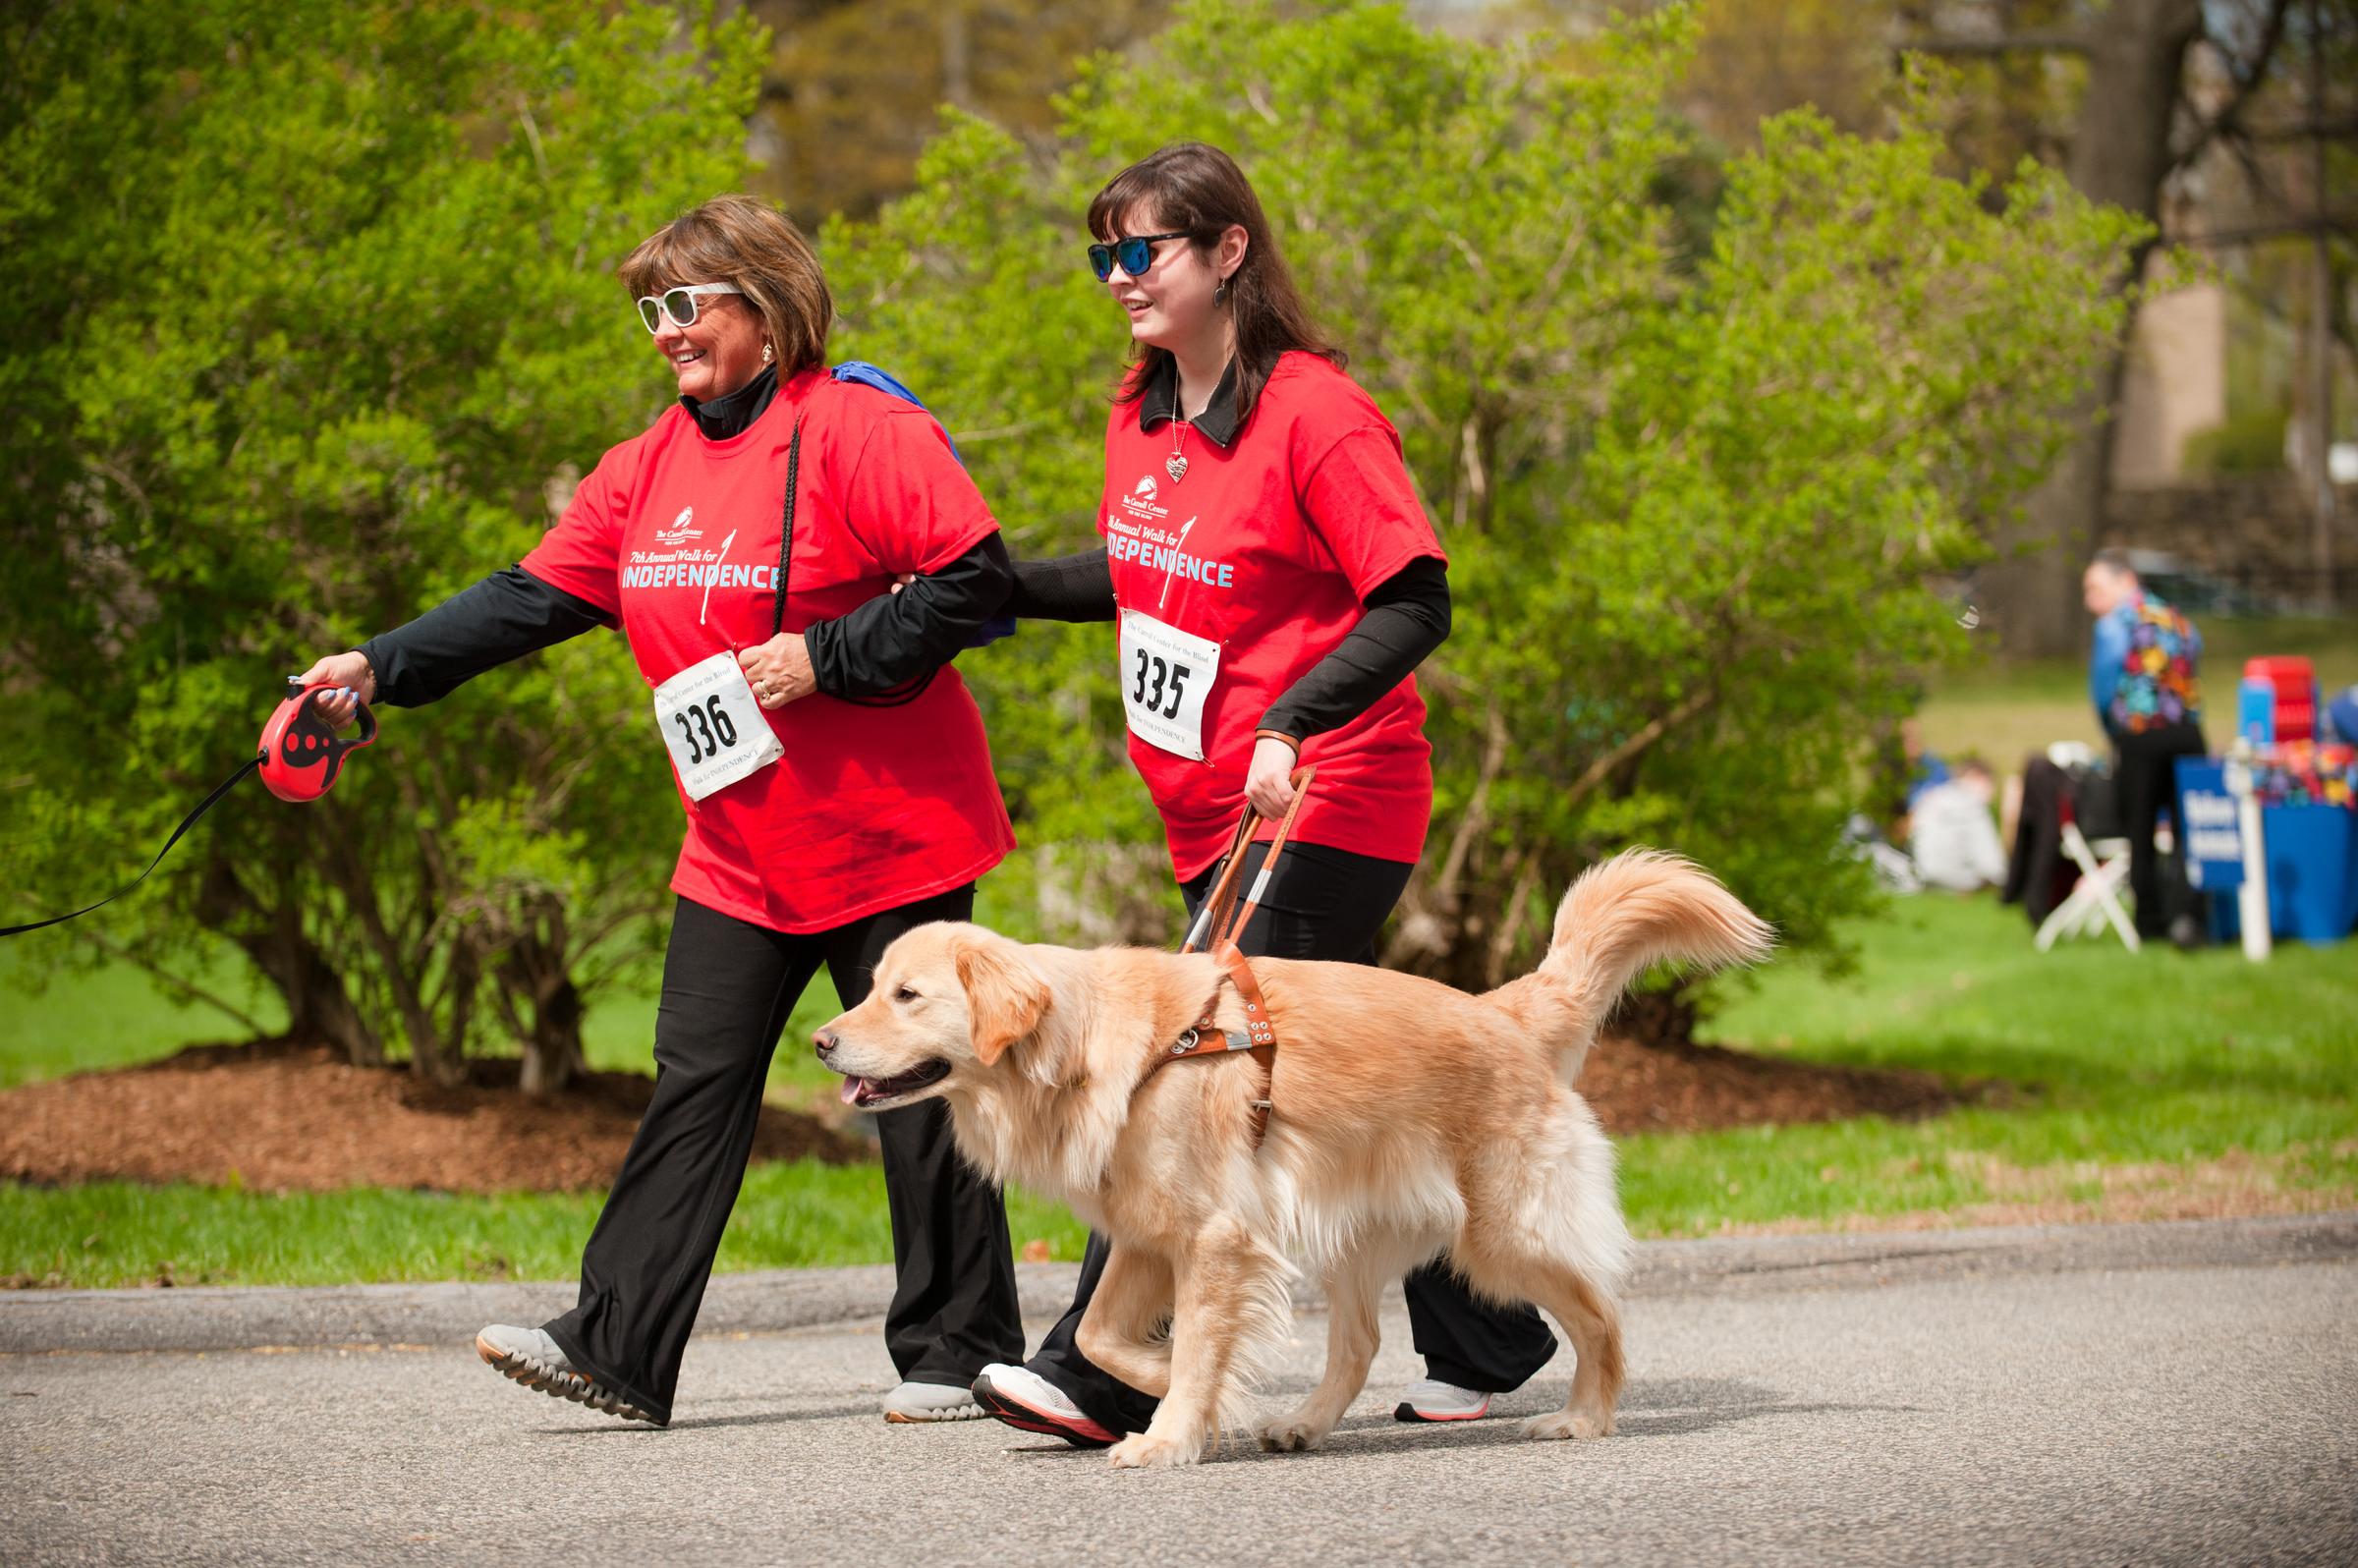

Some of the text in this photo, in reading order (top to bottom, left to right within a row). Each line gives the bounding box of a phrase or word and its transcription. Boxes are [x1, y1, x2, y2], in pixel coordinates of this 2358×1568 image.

[1148, 503, 1169, 516] Center
[1111, 518, 1141, 537] Annual
[1143, 526, 1166, 541] Walk
[1166, 532, 1178, 546] for
[630, 549, 718, 563] 7th Annual Walk for
[1107, 532, 1234, 588] DEPENDENCE
[622, 563, 779, 589] INDEPENDENCE
[1133, 647, 1191, 720] 335
[674, 694, 738, 764] 336
